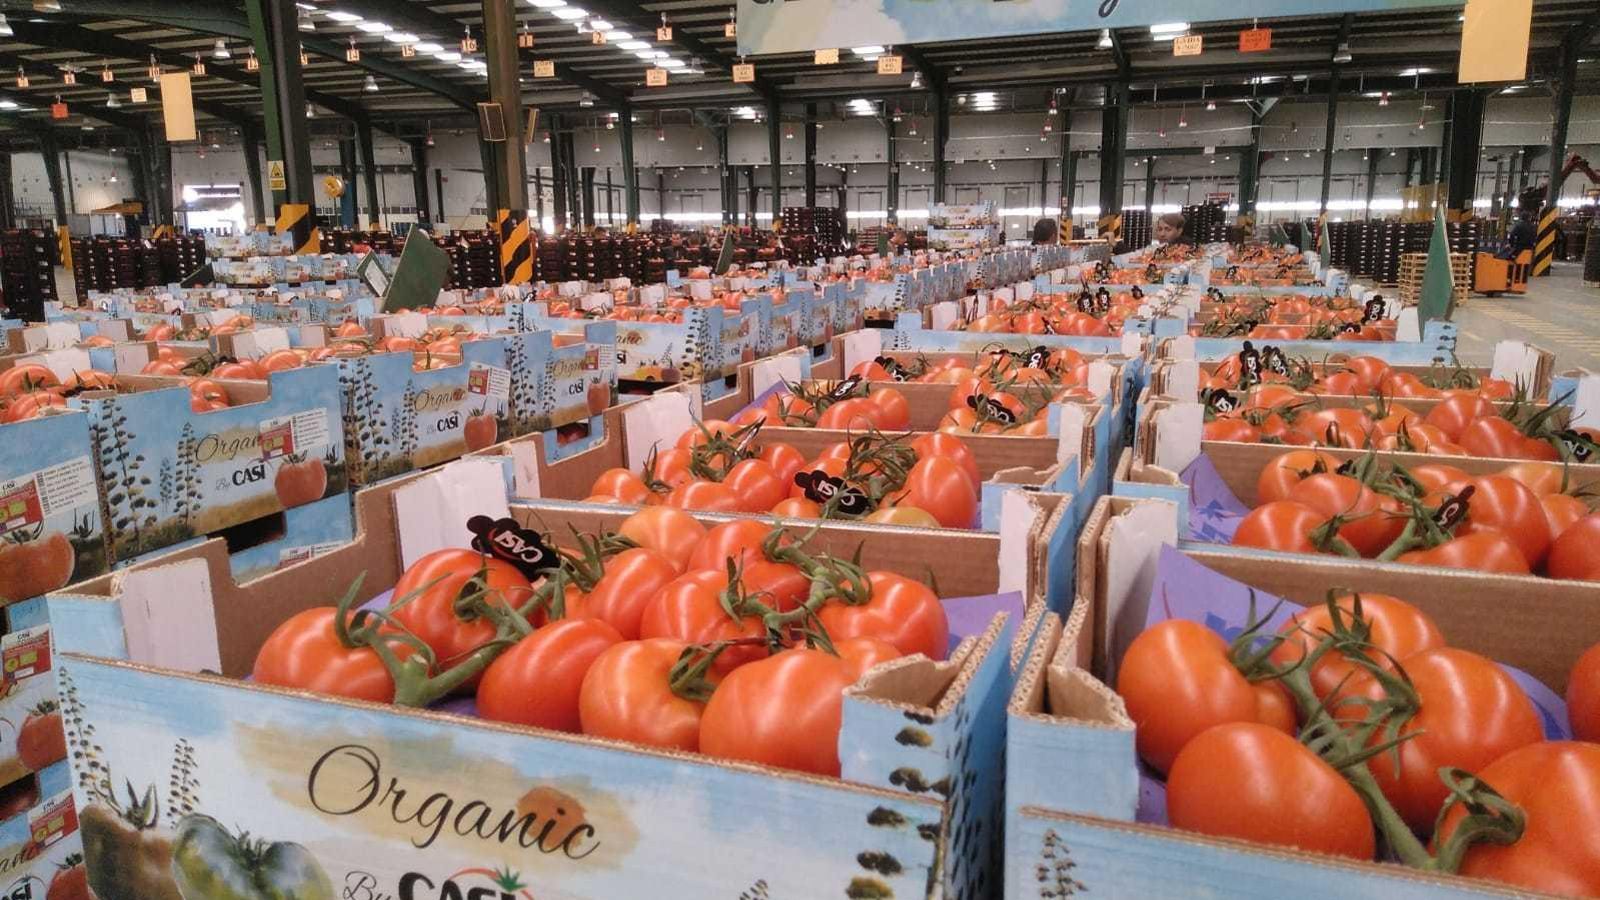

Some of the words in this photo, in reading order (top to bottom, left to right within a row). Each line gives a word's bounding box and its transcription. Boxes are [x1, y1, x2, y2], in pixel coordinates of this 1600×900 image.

[464, 39, 476, 51] 16
[616, 352, 627, 364] SI
[987, 404, 1010, 423] CAS
[437, 416, 459, 433] CASI
[232, 464, 266, 487] CASI
[494, 530, 543, 563] CASI
[308, 744, 601, 860] Organic
[343, 870, 391, 900] B
